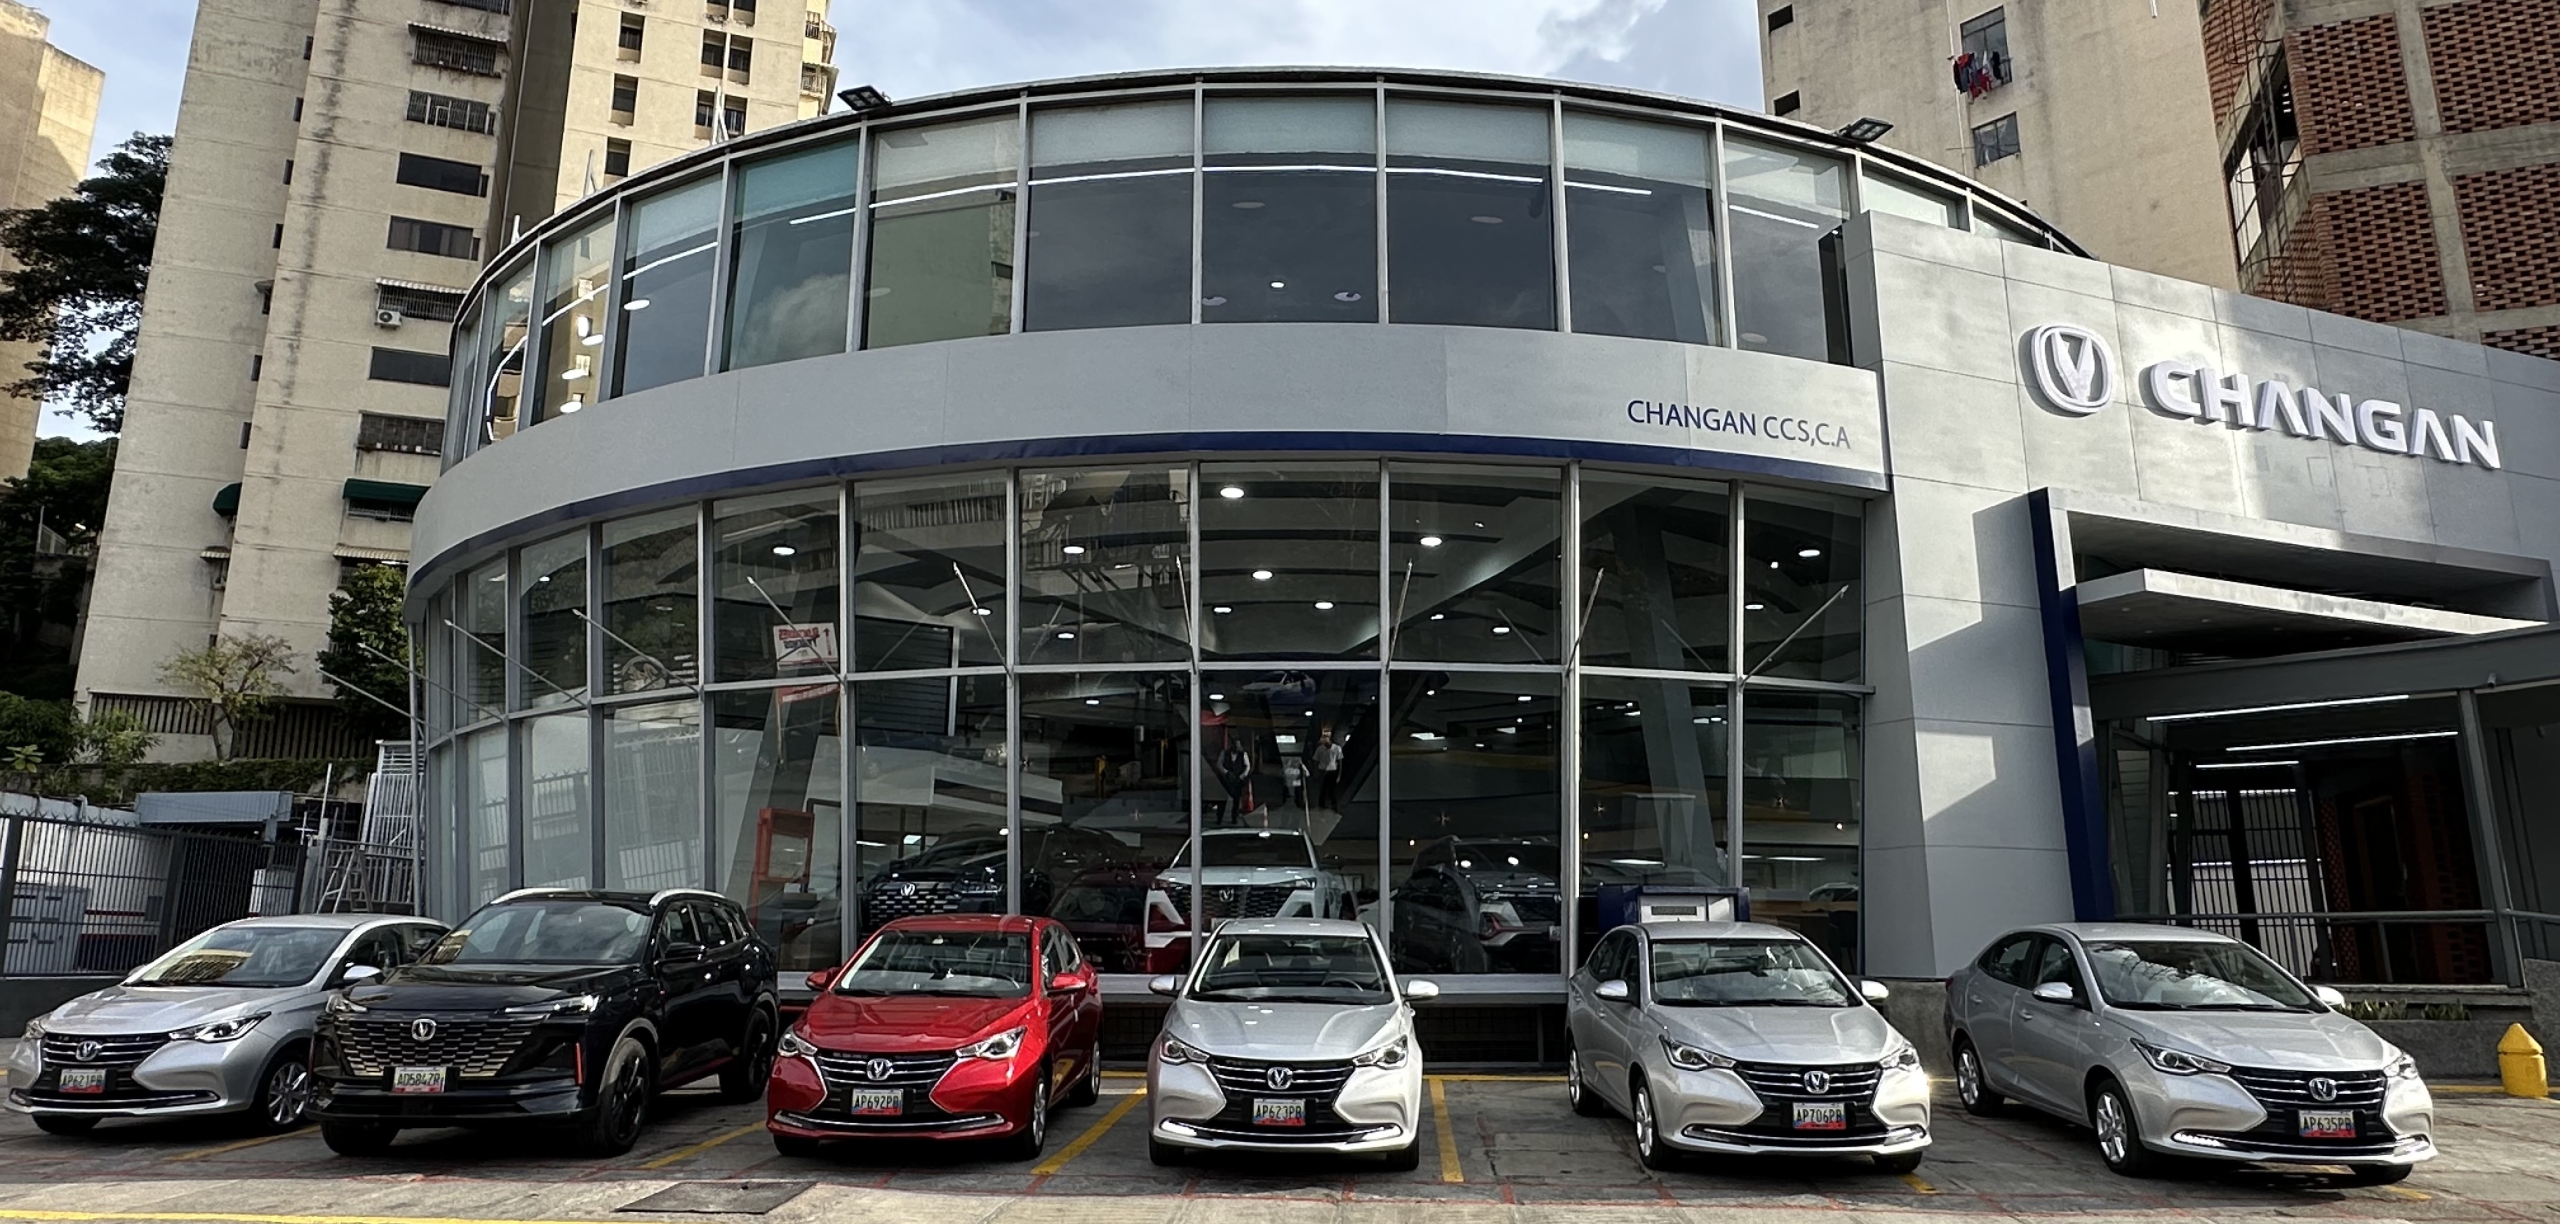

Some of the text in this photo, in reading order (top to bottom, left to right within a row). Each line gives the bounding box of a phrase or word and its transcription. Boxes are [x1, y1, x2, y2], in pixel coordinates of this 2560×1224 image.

[1626, 399, 1852, 450] CHANGAN CCS,C.A
[2146, 359, 2501, 469] CHANGAN
[1796, 1108, 1843, 1123] AP706PB
